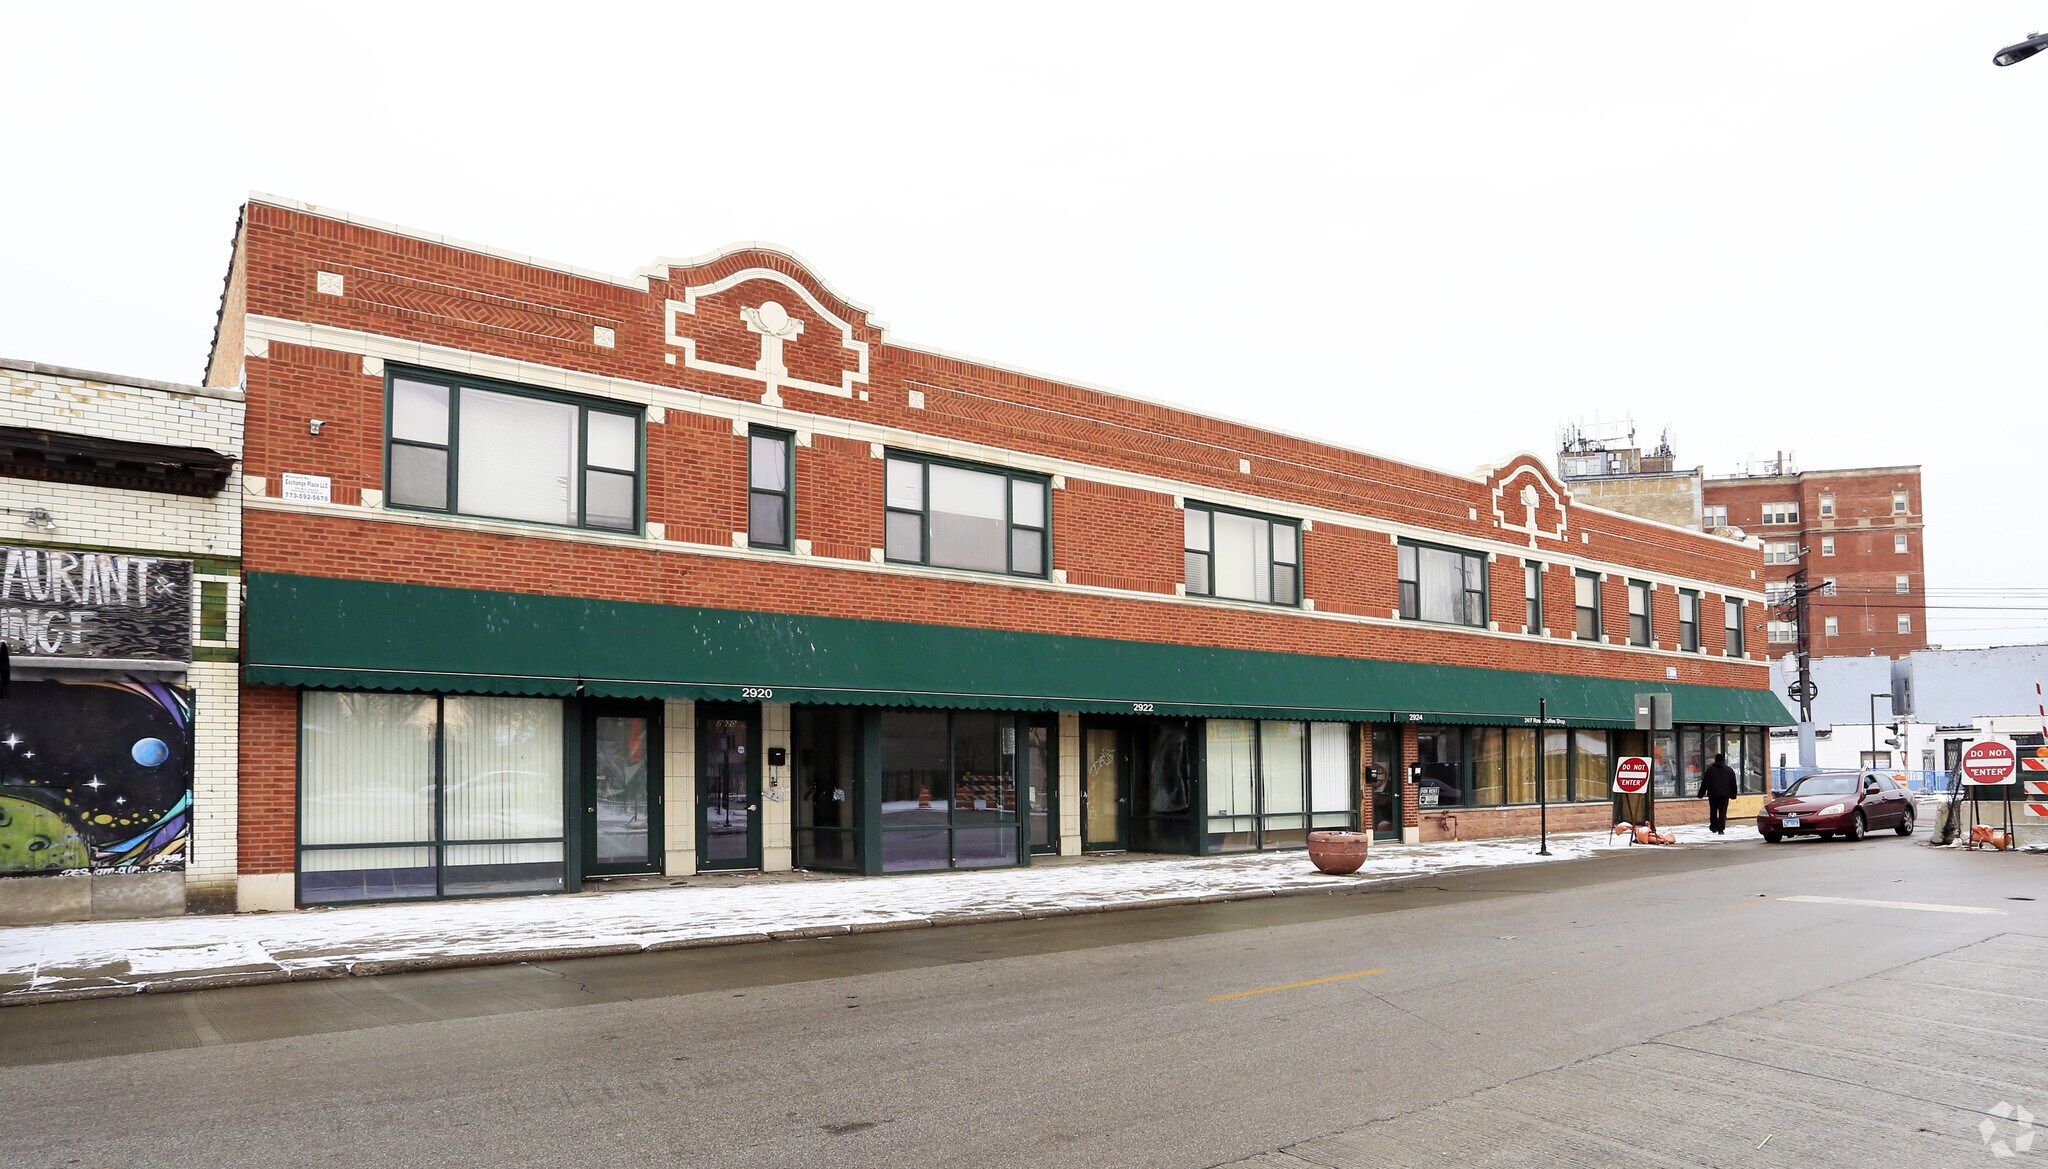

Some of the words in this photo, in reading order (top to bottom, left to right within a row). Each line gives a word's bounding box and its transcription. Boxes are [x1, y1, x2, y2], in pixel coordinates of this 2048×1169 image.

[285, 479, 306, 487] Exchange
[0, 548, 158, 608] AURANT
[742, 687, 772, 698] 2920
[1133, 703, 1154, 712] 2922
[1409, 713, 1423, 721] 2924
[1989, 749, 2008, 757] NOT
